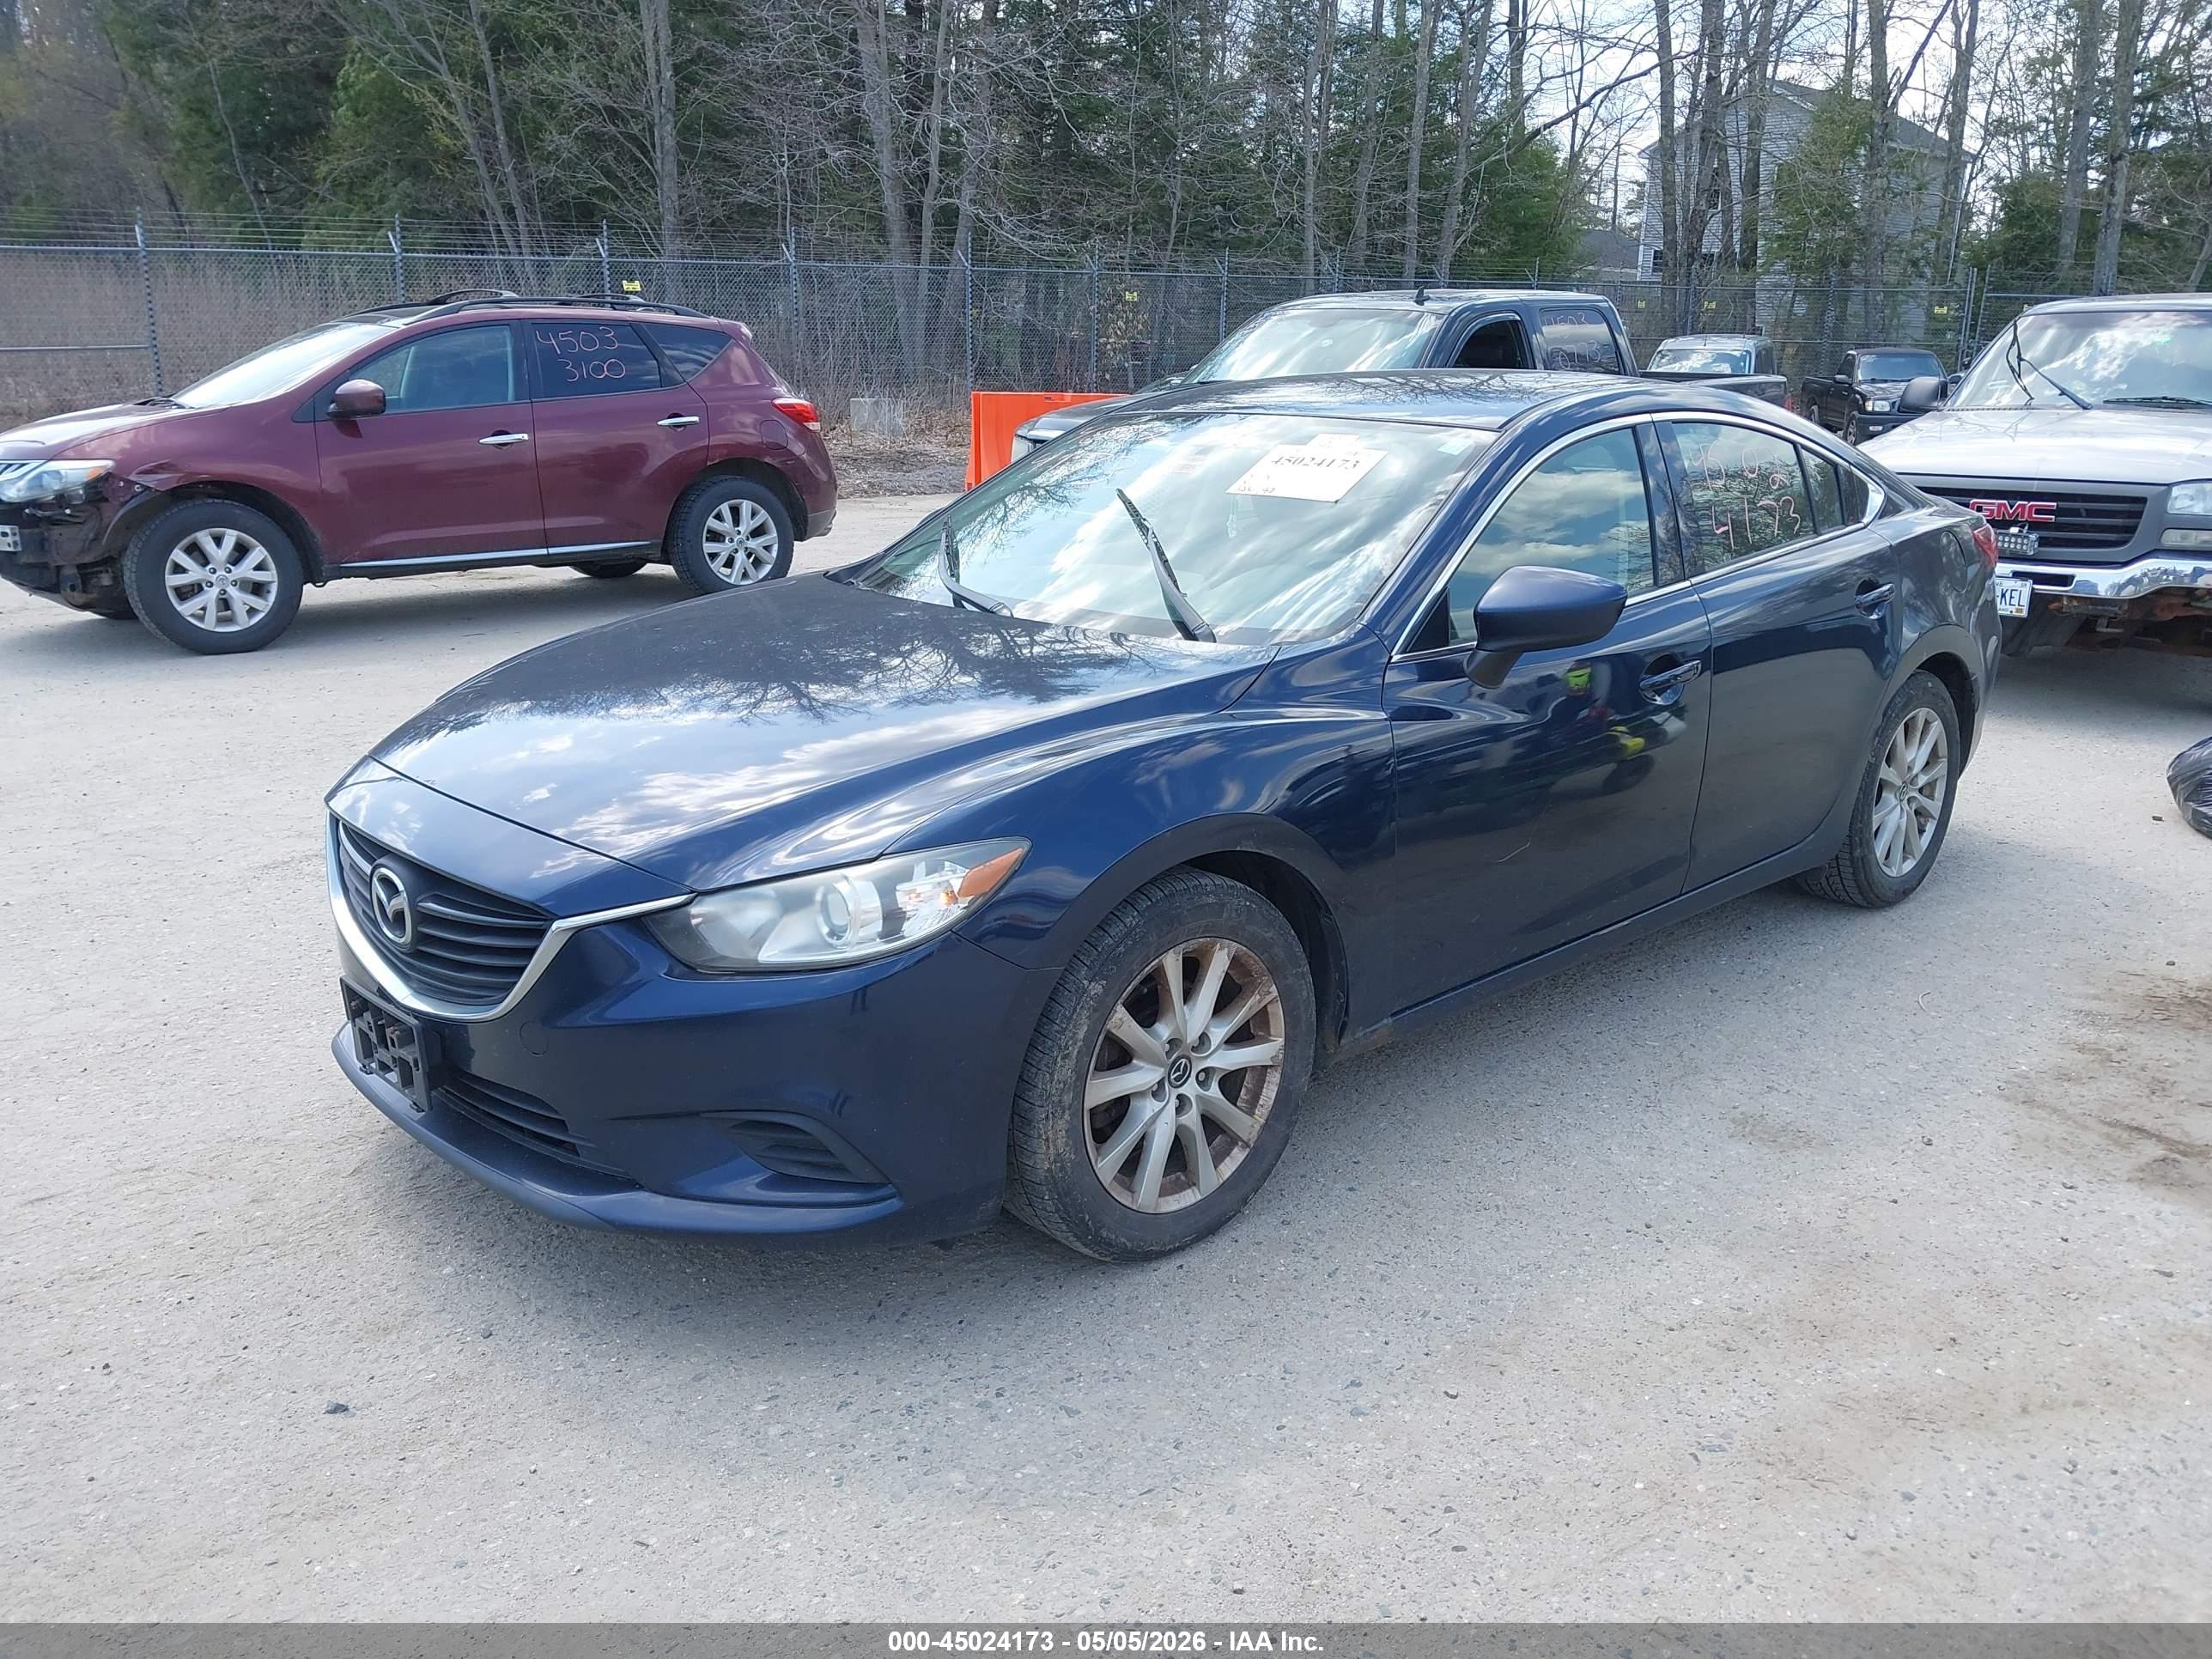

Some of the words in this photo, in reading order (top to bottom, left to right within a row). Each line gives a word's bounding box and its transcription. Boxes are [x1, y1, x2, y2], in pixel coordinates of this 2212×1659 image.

[535, 325, 619, 355] 4503
[557, 358, 626, 382] 3100
[1271, 455, 1361, 471] 45024173
[1711, 495, 1801, 550] 4173
[1969, 499, 2057, 522] GMC
